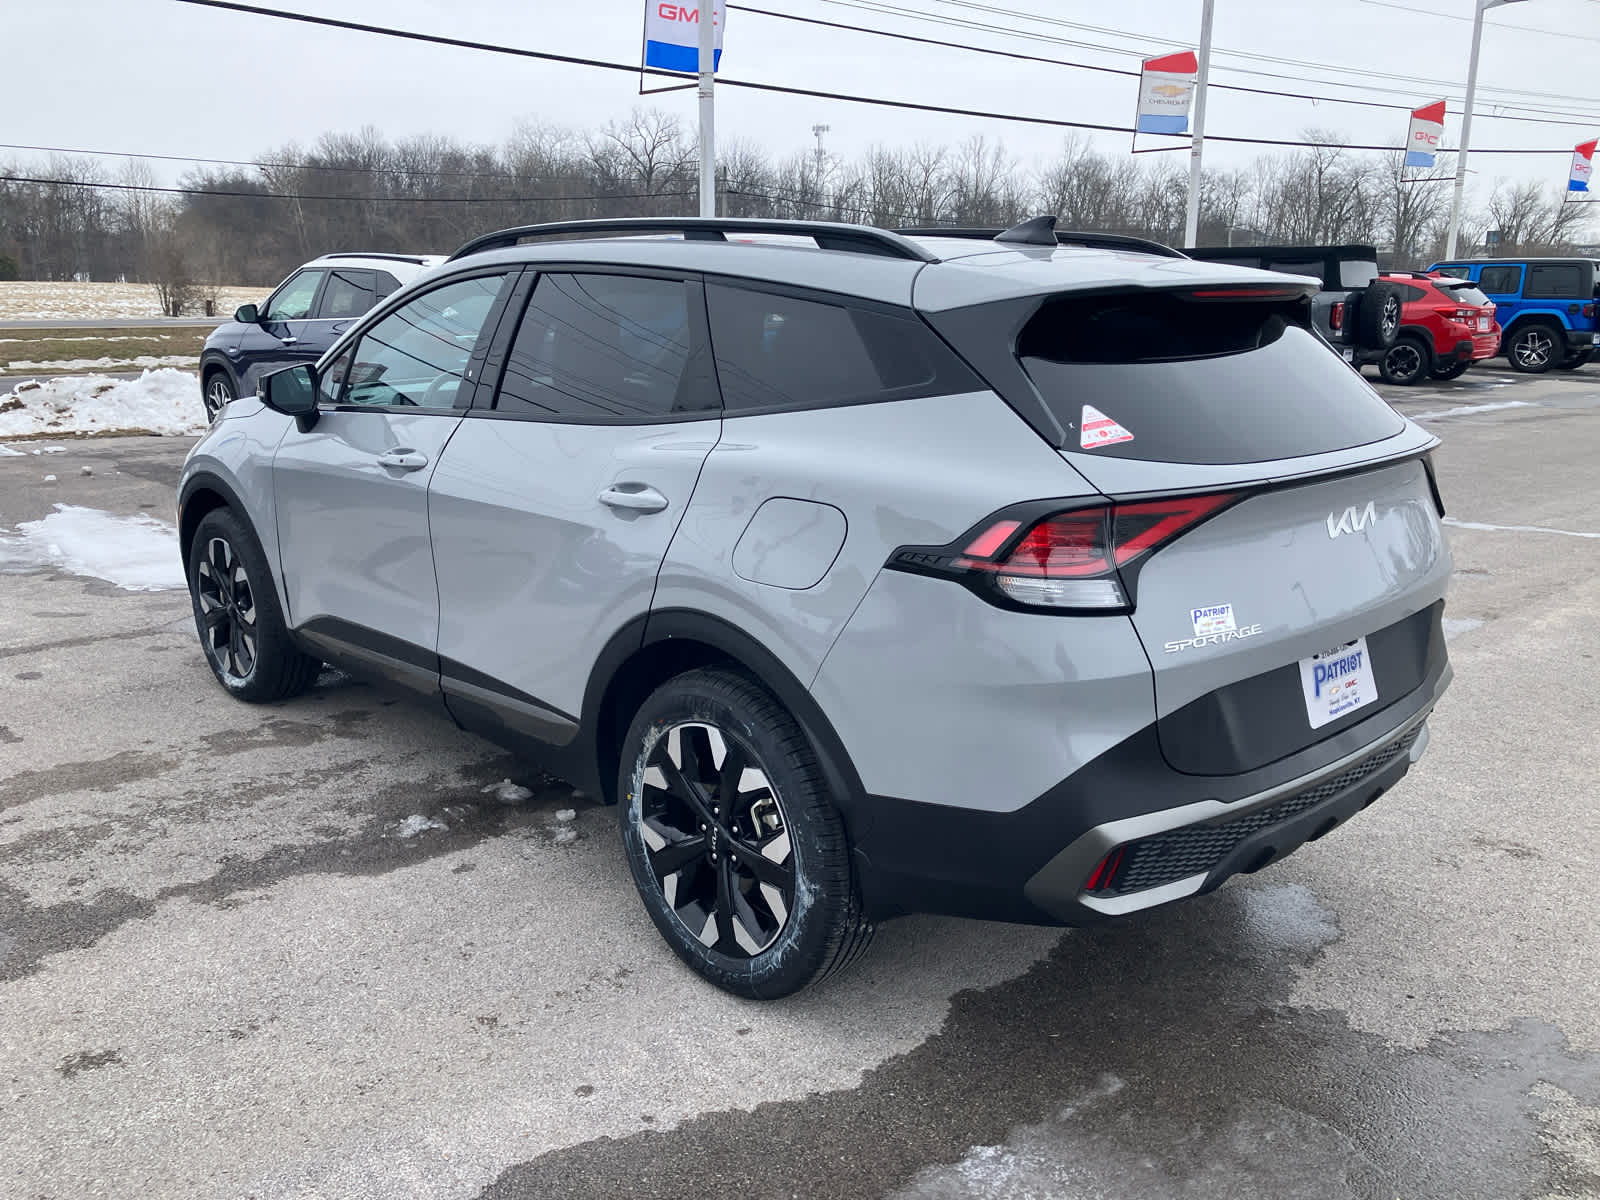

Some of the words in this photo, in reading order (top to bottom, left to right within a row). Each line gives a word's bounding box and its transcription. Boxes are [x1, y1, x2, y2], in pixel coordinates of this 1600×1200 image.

[1193, 605, 1230, 625] PATRIOT
[1164, 623, 1263, 653] SPORTAGE
[1313, 651, 1363, 697] PATRIOT
